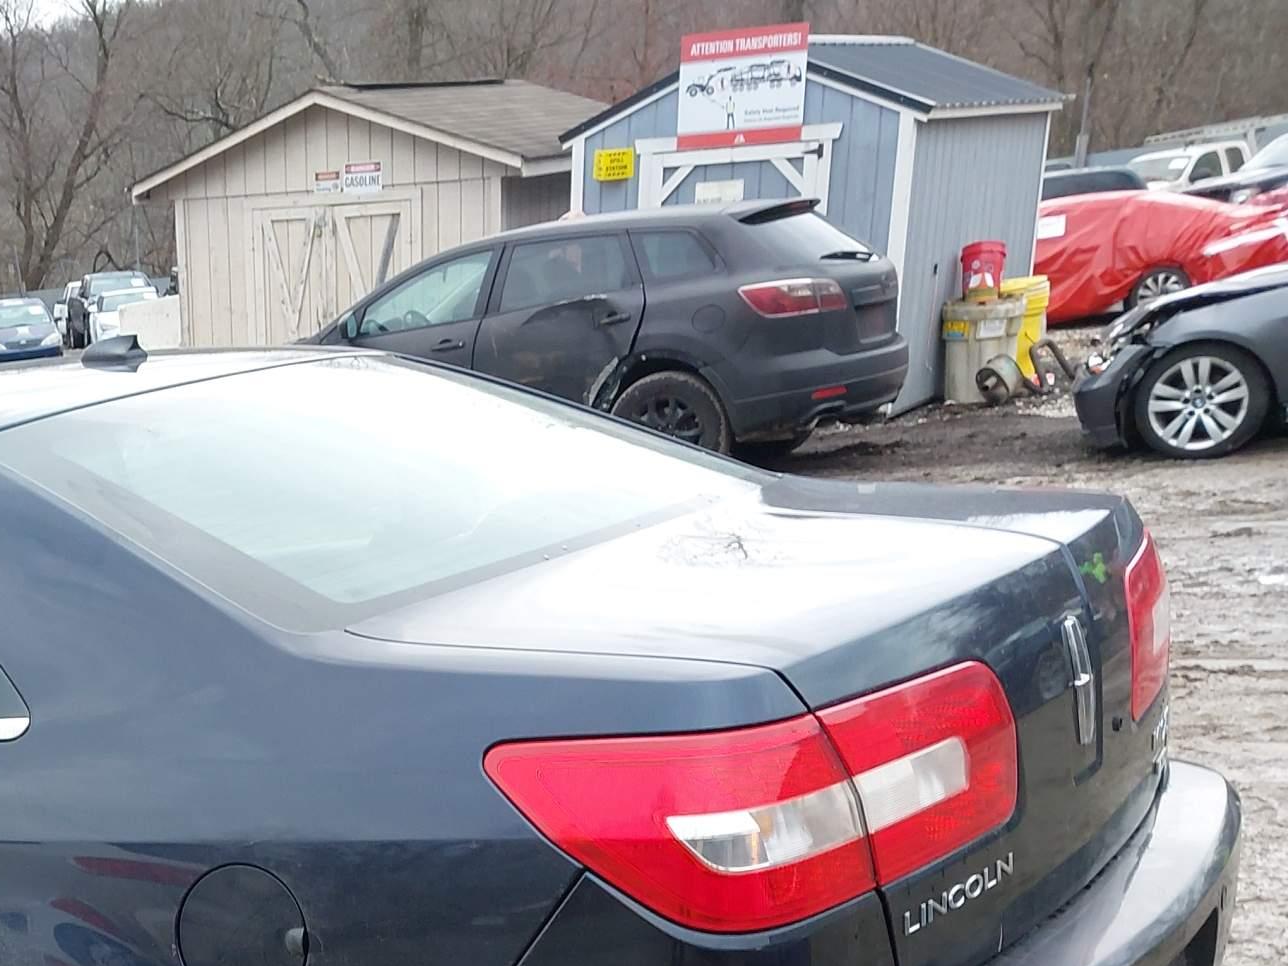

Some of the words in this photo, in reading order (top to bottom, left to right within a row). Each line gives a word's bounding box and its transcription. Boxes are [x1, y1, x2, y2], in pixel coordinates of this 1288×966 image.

[690, 39, 733, 56] ATTENTION
[735, 32, 802, 52] TRANSPORTERS!
[345, 175, 381, 188] GASOLINE
[904, 851, 1014, 937] LINCOLN
